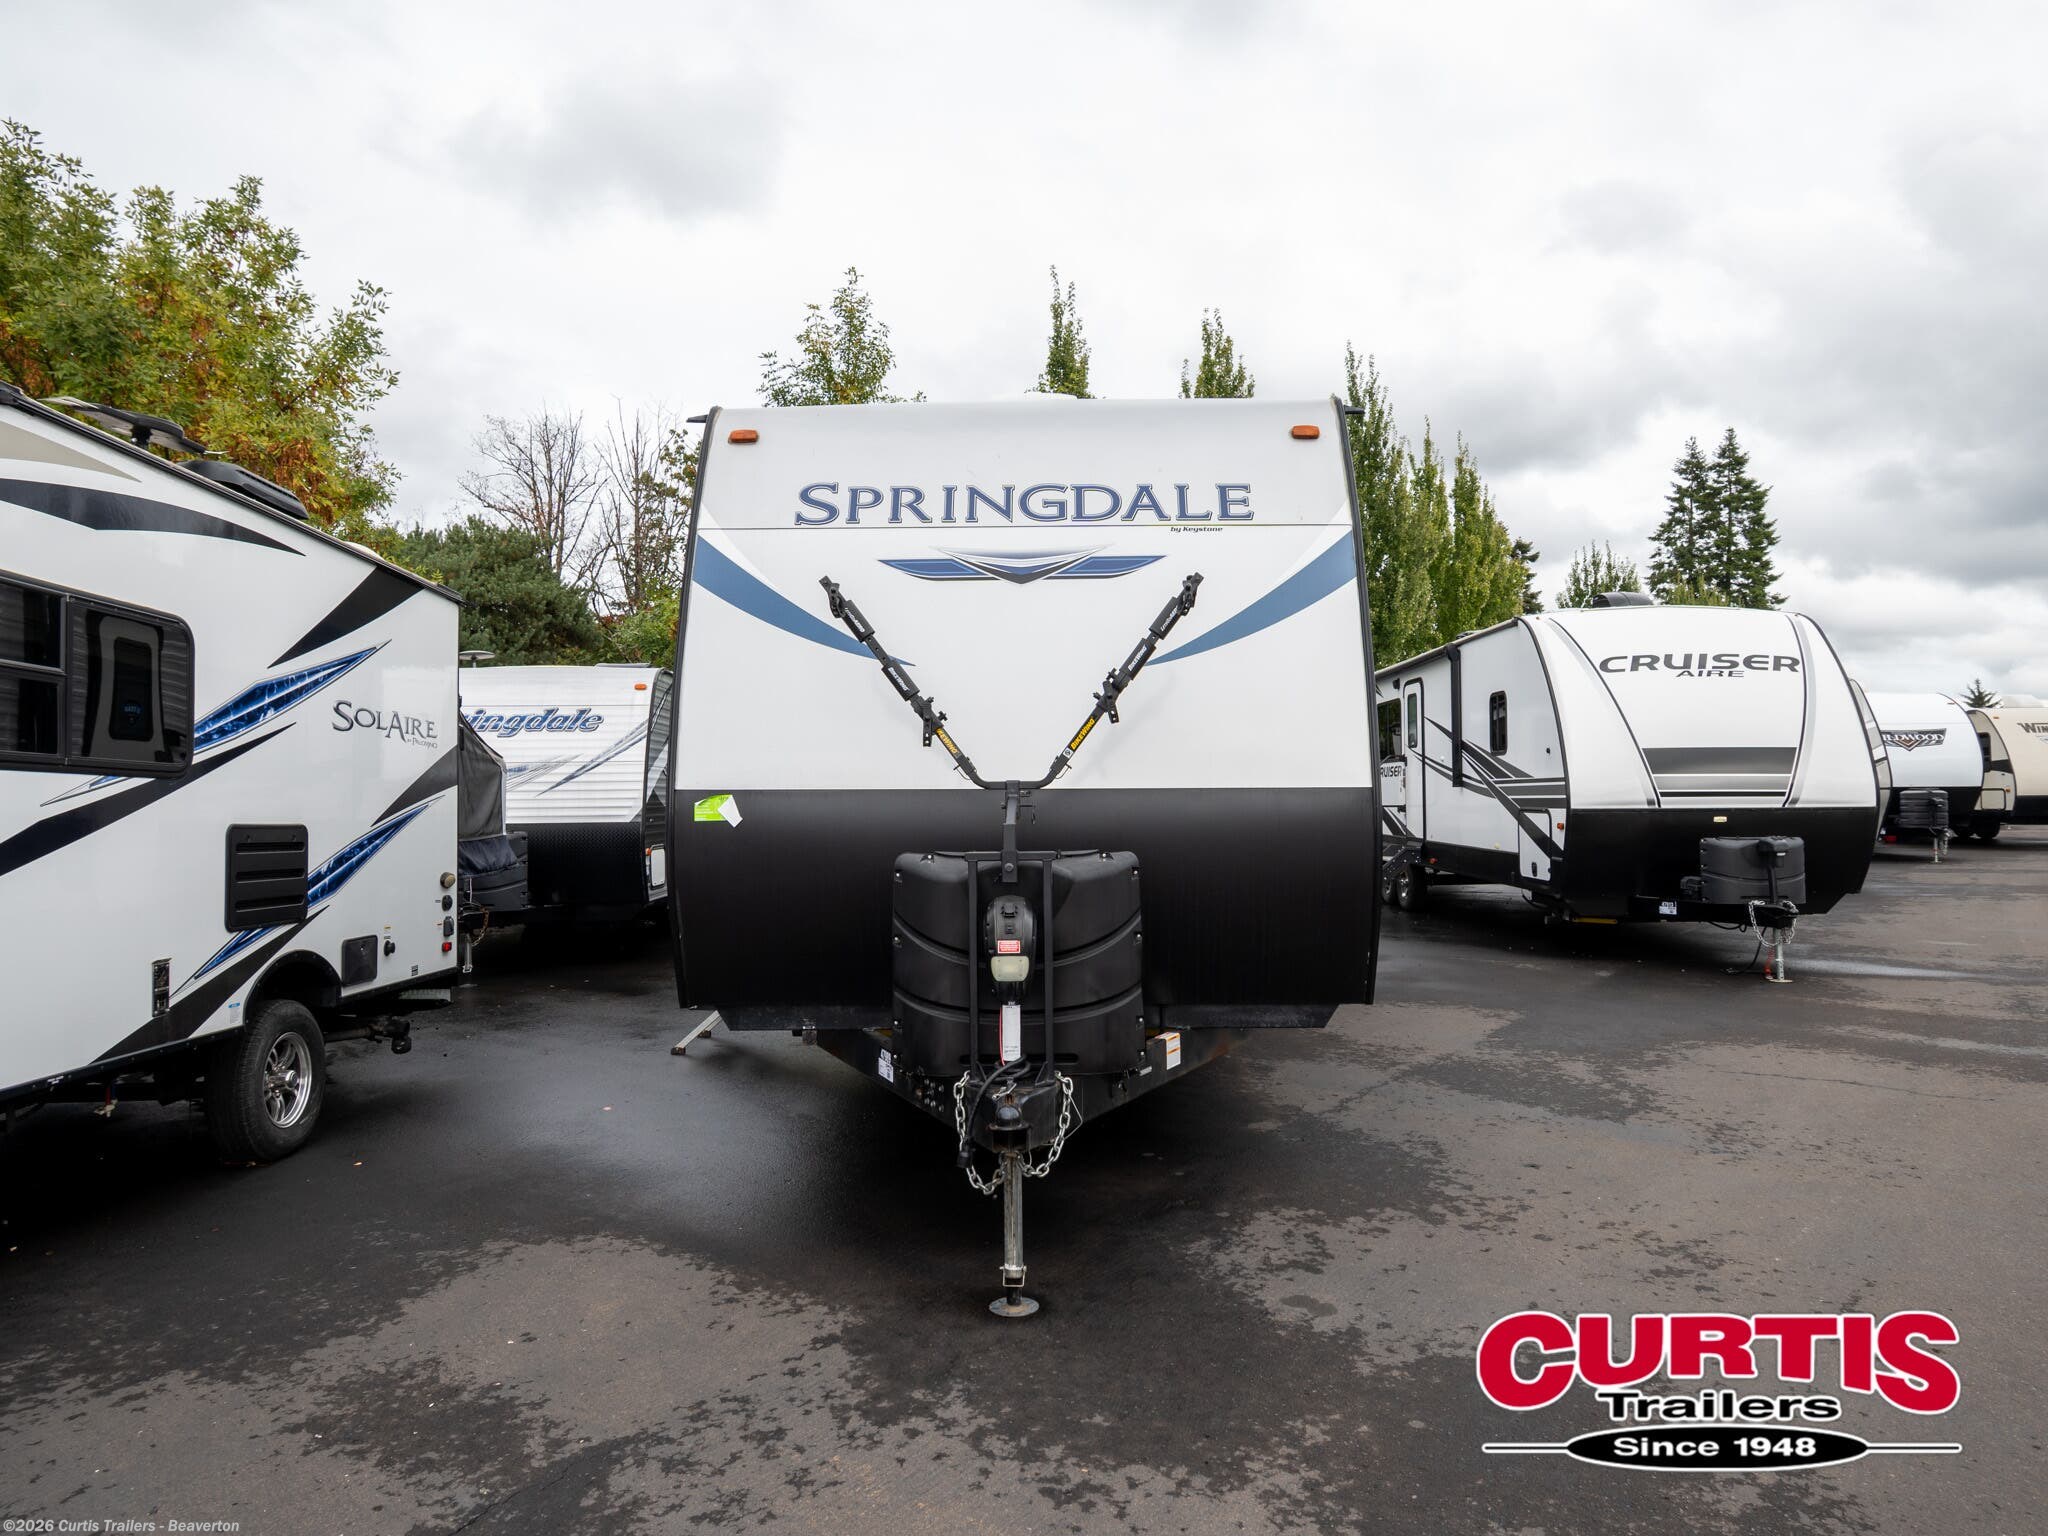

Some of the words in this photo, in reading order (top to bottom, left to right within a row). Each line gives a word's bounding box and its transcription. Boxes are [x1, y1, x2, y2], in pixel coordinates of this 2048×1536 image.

[793, 481, 1254, 525] SPRINGDALE
[1599, 653, 1800, 673] CRUISER
[1676, 670, 1745, 678] AIRE
[1070, 717, 1095, 750] BIKEWING
